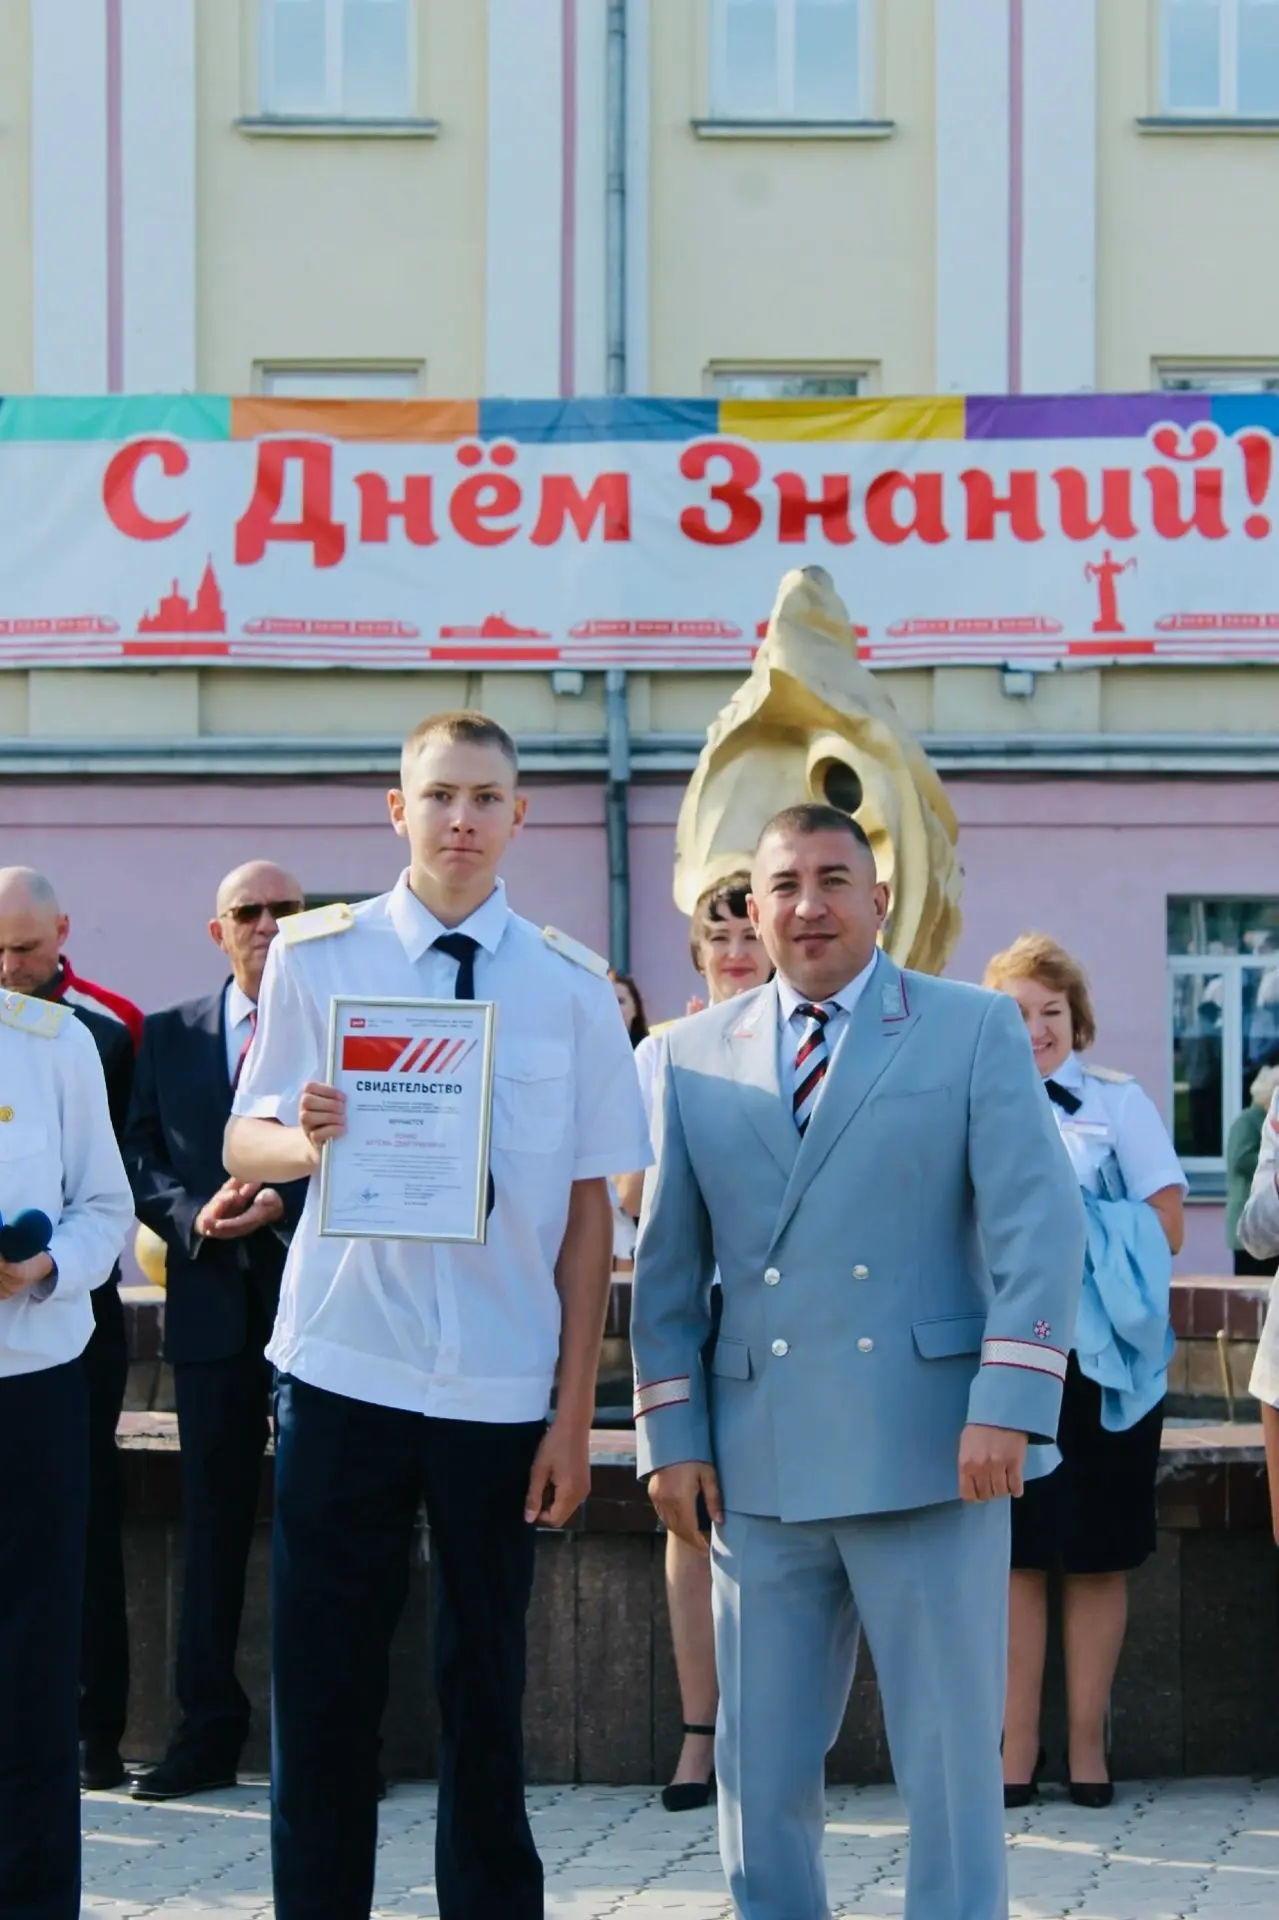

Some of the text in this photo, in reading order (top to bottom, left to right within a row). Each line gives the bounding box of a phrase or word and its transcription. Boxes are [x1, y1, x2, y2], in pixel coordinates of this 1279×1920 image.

[103, 427, 1273, 568] С Днём Знаний!
[355, 1080, 463, 1095] СВИДЕТЕЛЬСТВО
